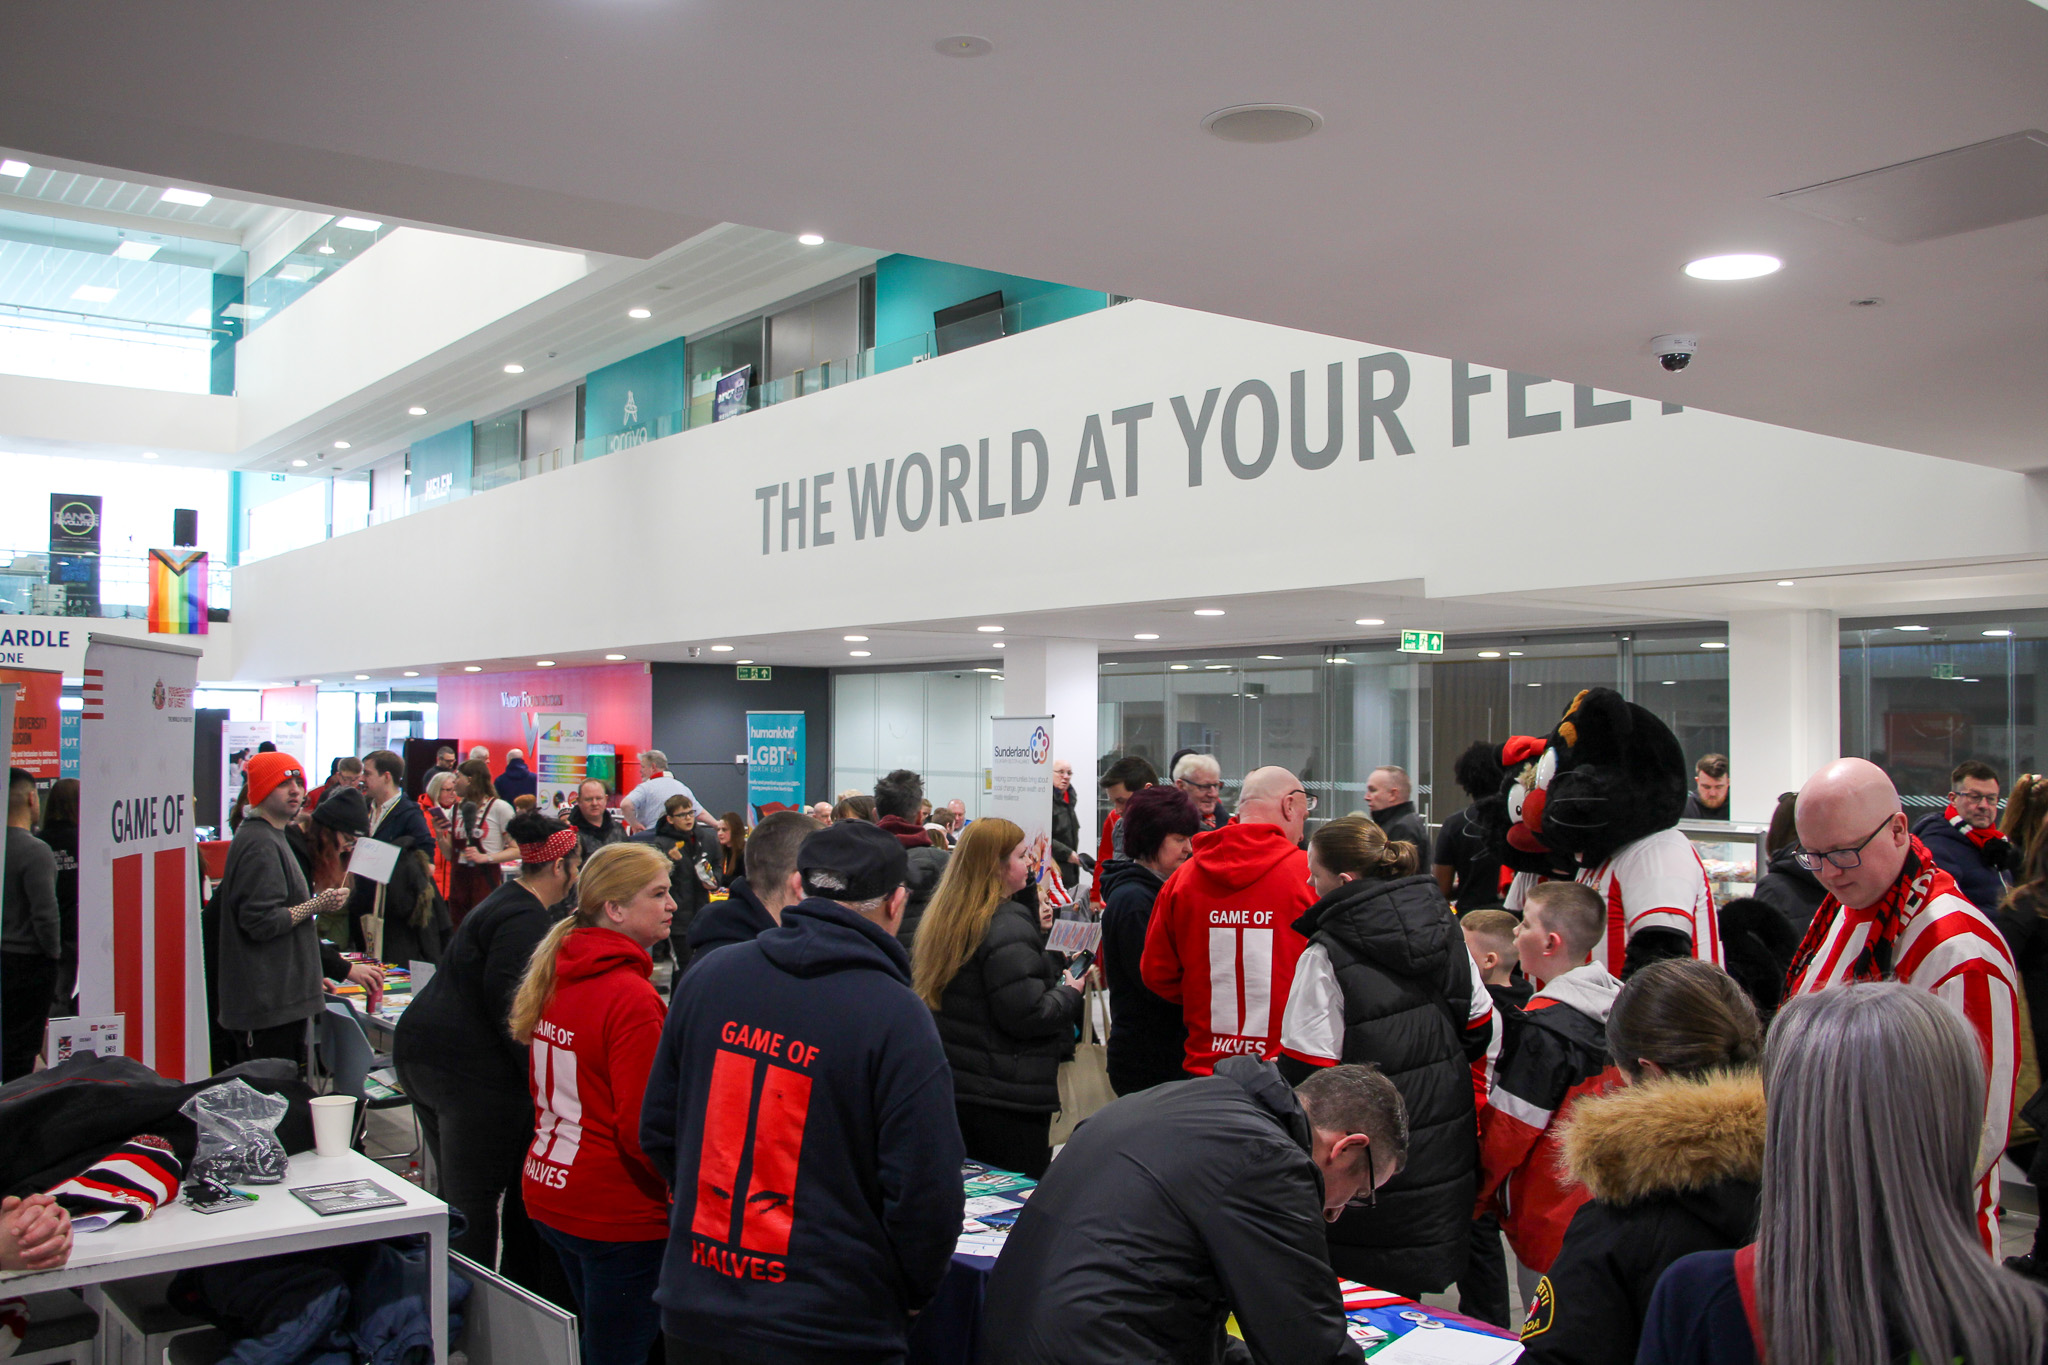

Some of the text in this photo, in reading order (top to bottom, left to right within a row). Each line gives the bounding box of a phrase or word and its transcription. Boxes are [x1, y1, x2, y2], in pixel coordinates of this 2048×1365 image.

[755, 351, 1684, 555] THE WORLD AT YOUR FE
[53, 511, 100, 521] DANCE
[53, 519, 100, 528] REVOLUTION
[0, 629, 70, 648] ARDLE
[1404, 632, 1417, 641] Fire
[1404, 641, 1417, 650] exit
[19, 717, 47, 730] DIVERSITY
[12, 733, 32, 745] LUSION
[994, 746, 1030, 757] Sunderland
[749, 765, 768, 773] NORTH
[112, 794, 185, 843] GAME OF
[1209, 910, 1273, 925] GAME OF
[557, 1028, 575, 1046] OF
[721, 1020, 820, 1068] GAME OF
[1211, 1037, 1266, 1056] HALVES
[524, 1158, 569, 1190] HALVES
[692, 1239, 787, 1283] HALVES
